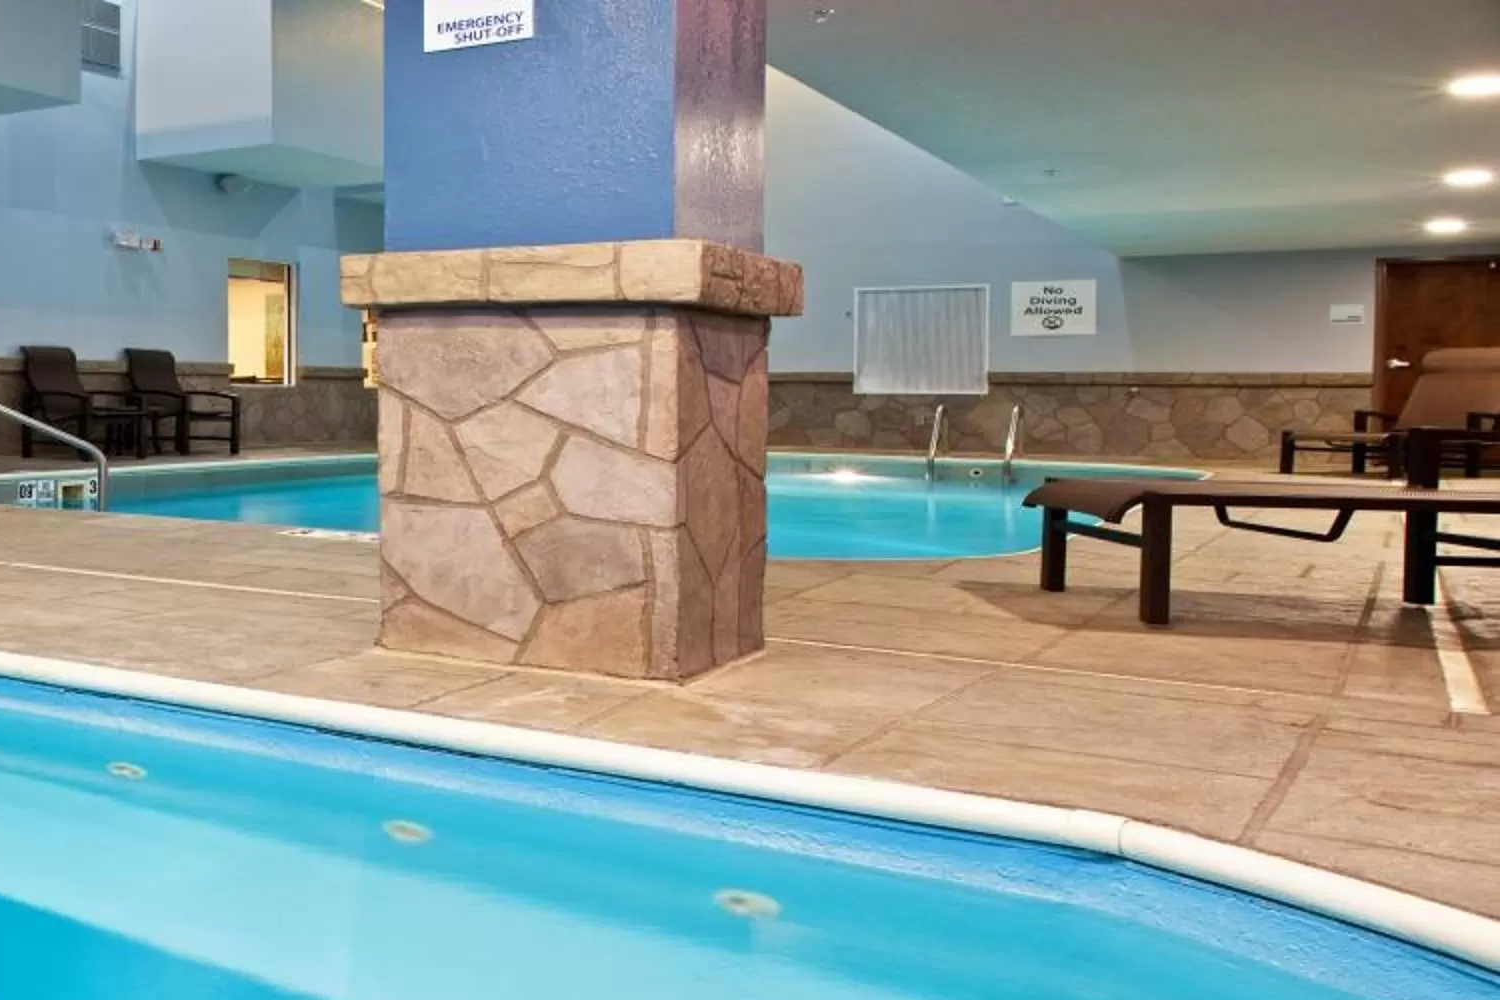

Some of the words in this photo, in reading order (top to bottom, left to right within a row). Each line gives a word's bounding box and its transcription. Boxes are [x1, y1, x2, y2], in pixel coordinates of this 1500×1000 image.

[437, 11, 524, 35] EMERGENCY
[453, 24, 525, 44] SHUT-OFF
[1043, 286, 1064, 295] No
[1030, 296, 1077, 306] Diving
[1024, 306, 1083, 315] Allowed
